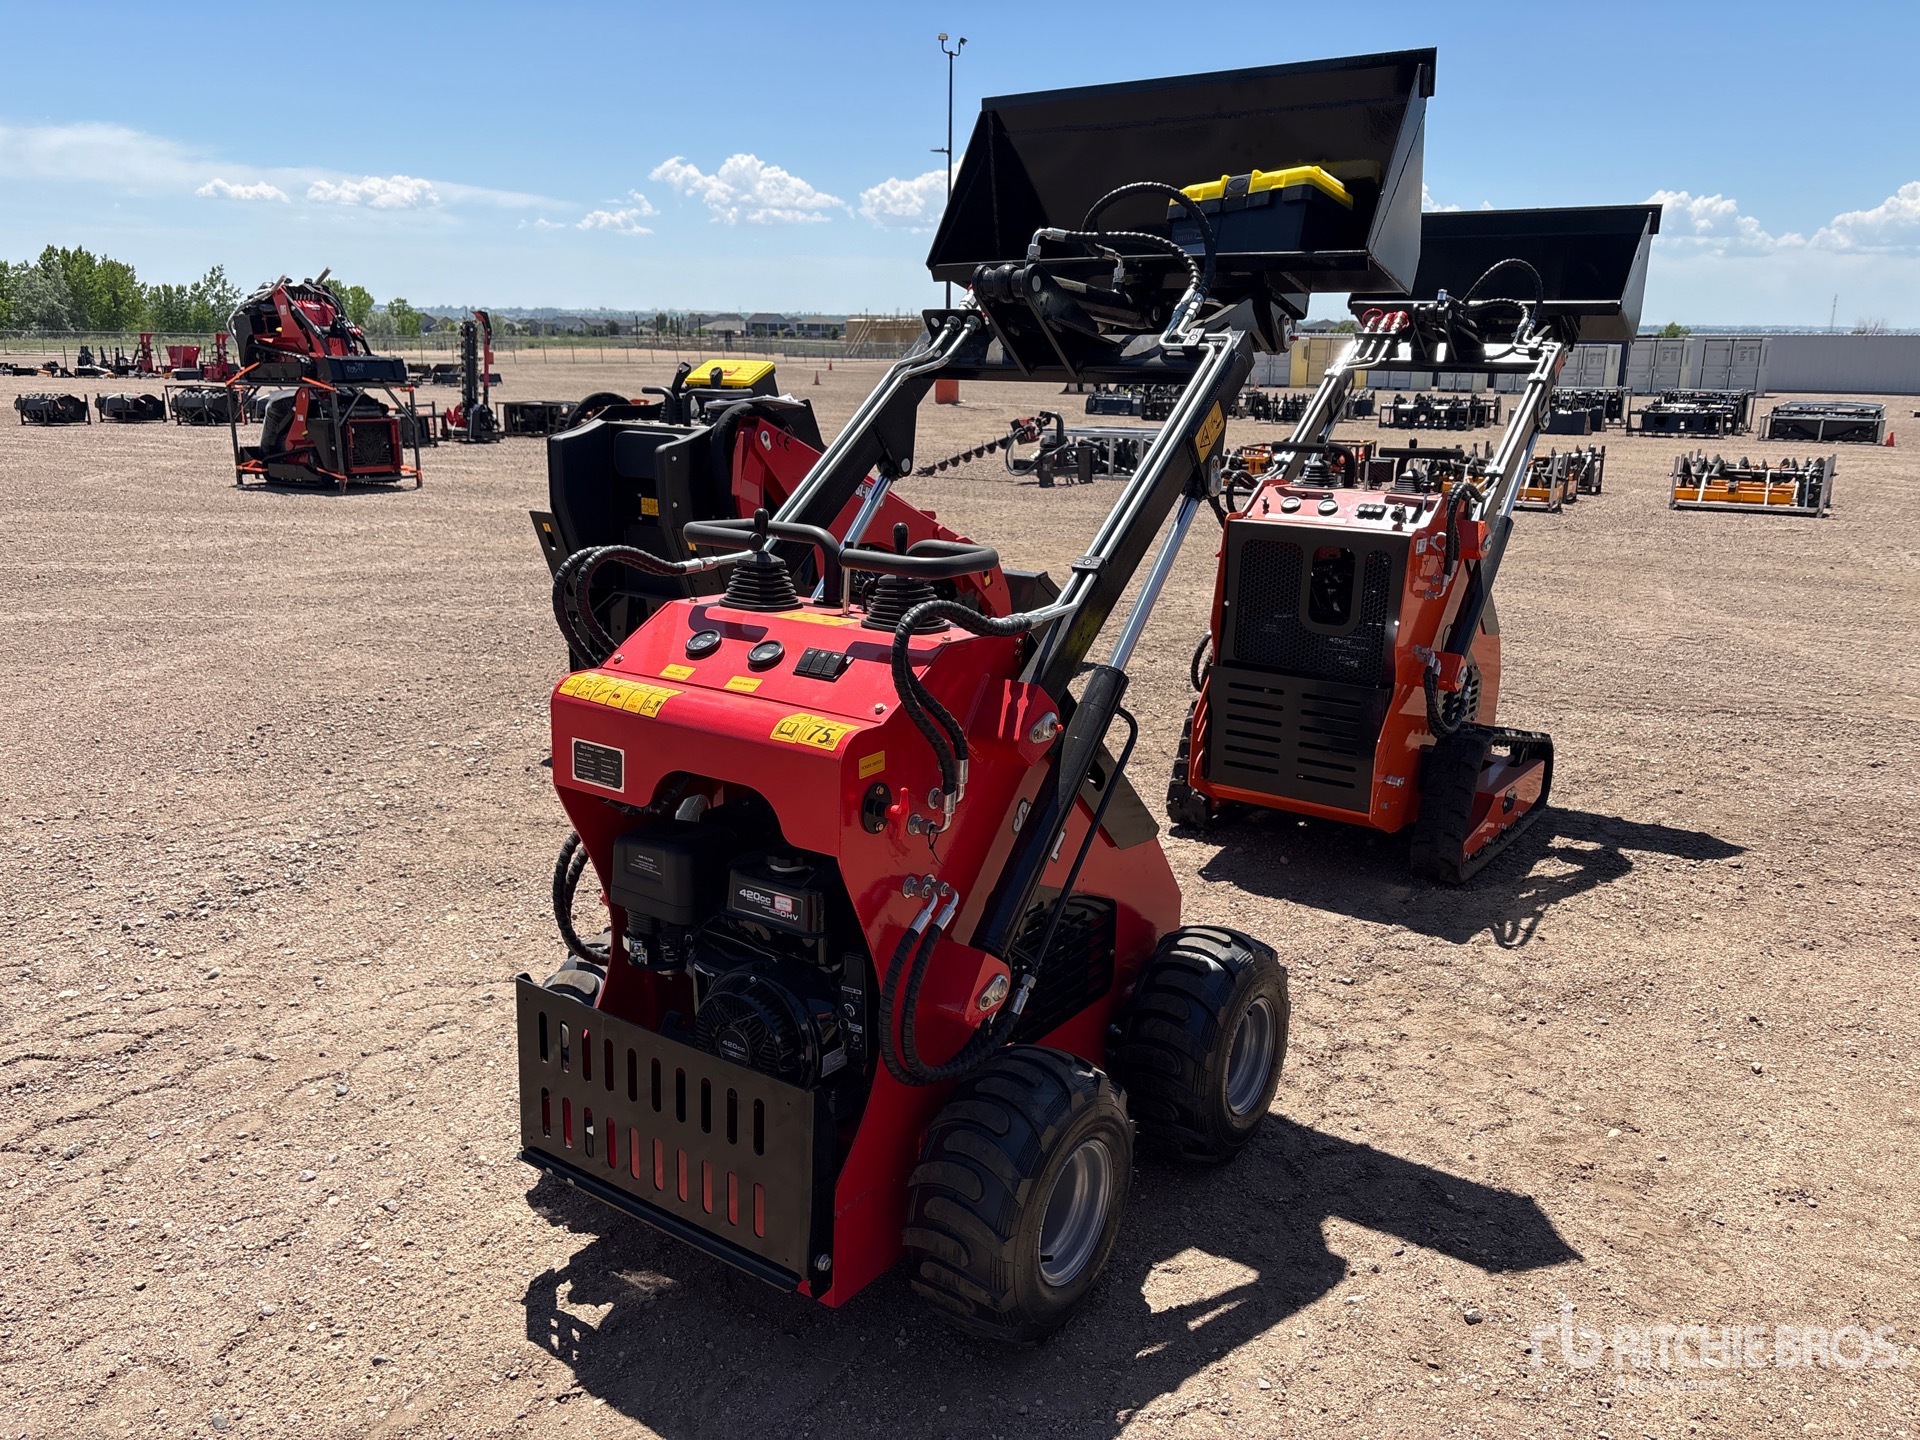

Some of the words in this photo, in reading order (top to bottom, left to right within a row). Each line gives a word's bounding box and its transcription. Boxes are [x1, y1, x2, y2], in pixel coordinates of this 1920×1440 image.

[806, 725, 837, 744] 75
[739, 888, 771, 904] 420cc
[780, 910, 798, 921] OHV
[722, 1040, 746, 1053] 420cc
